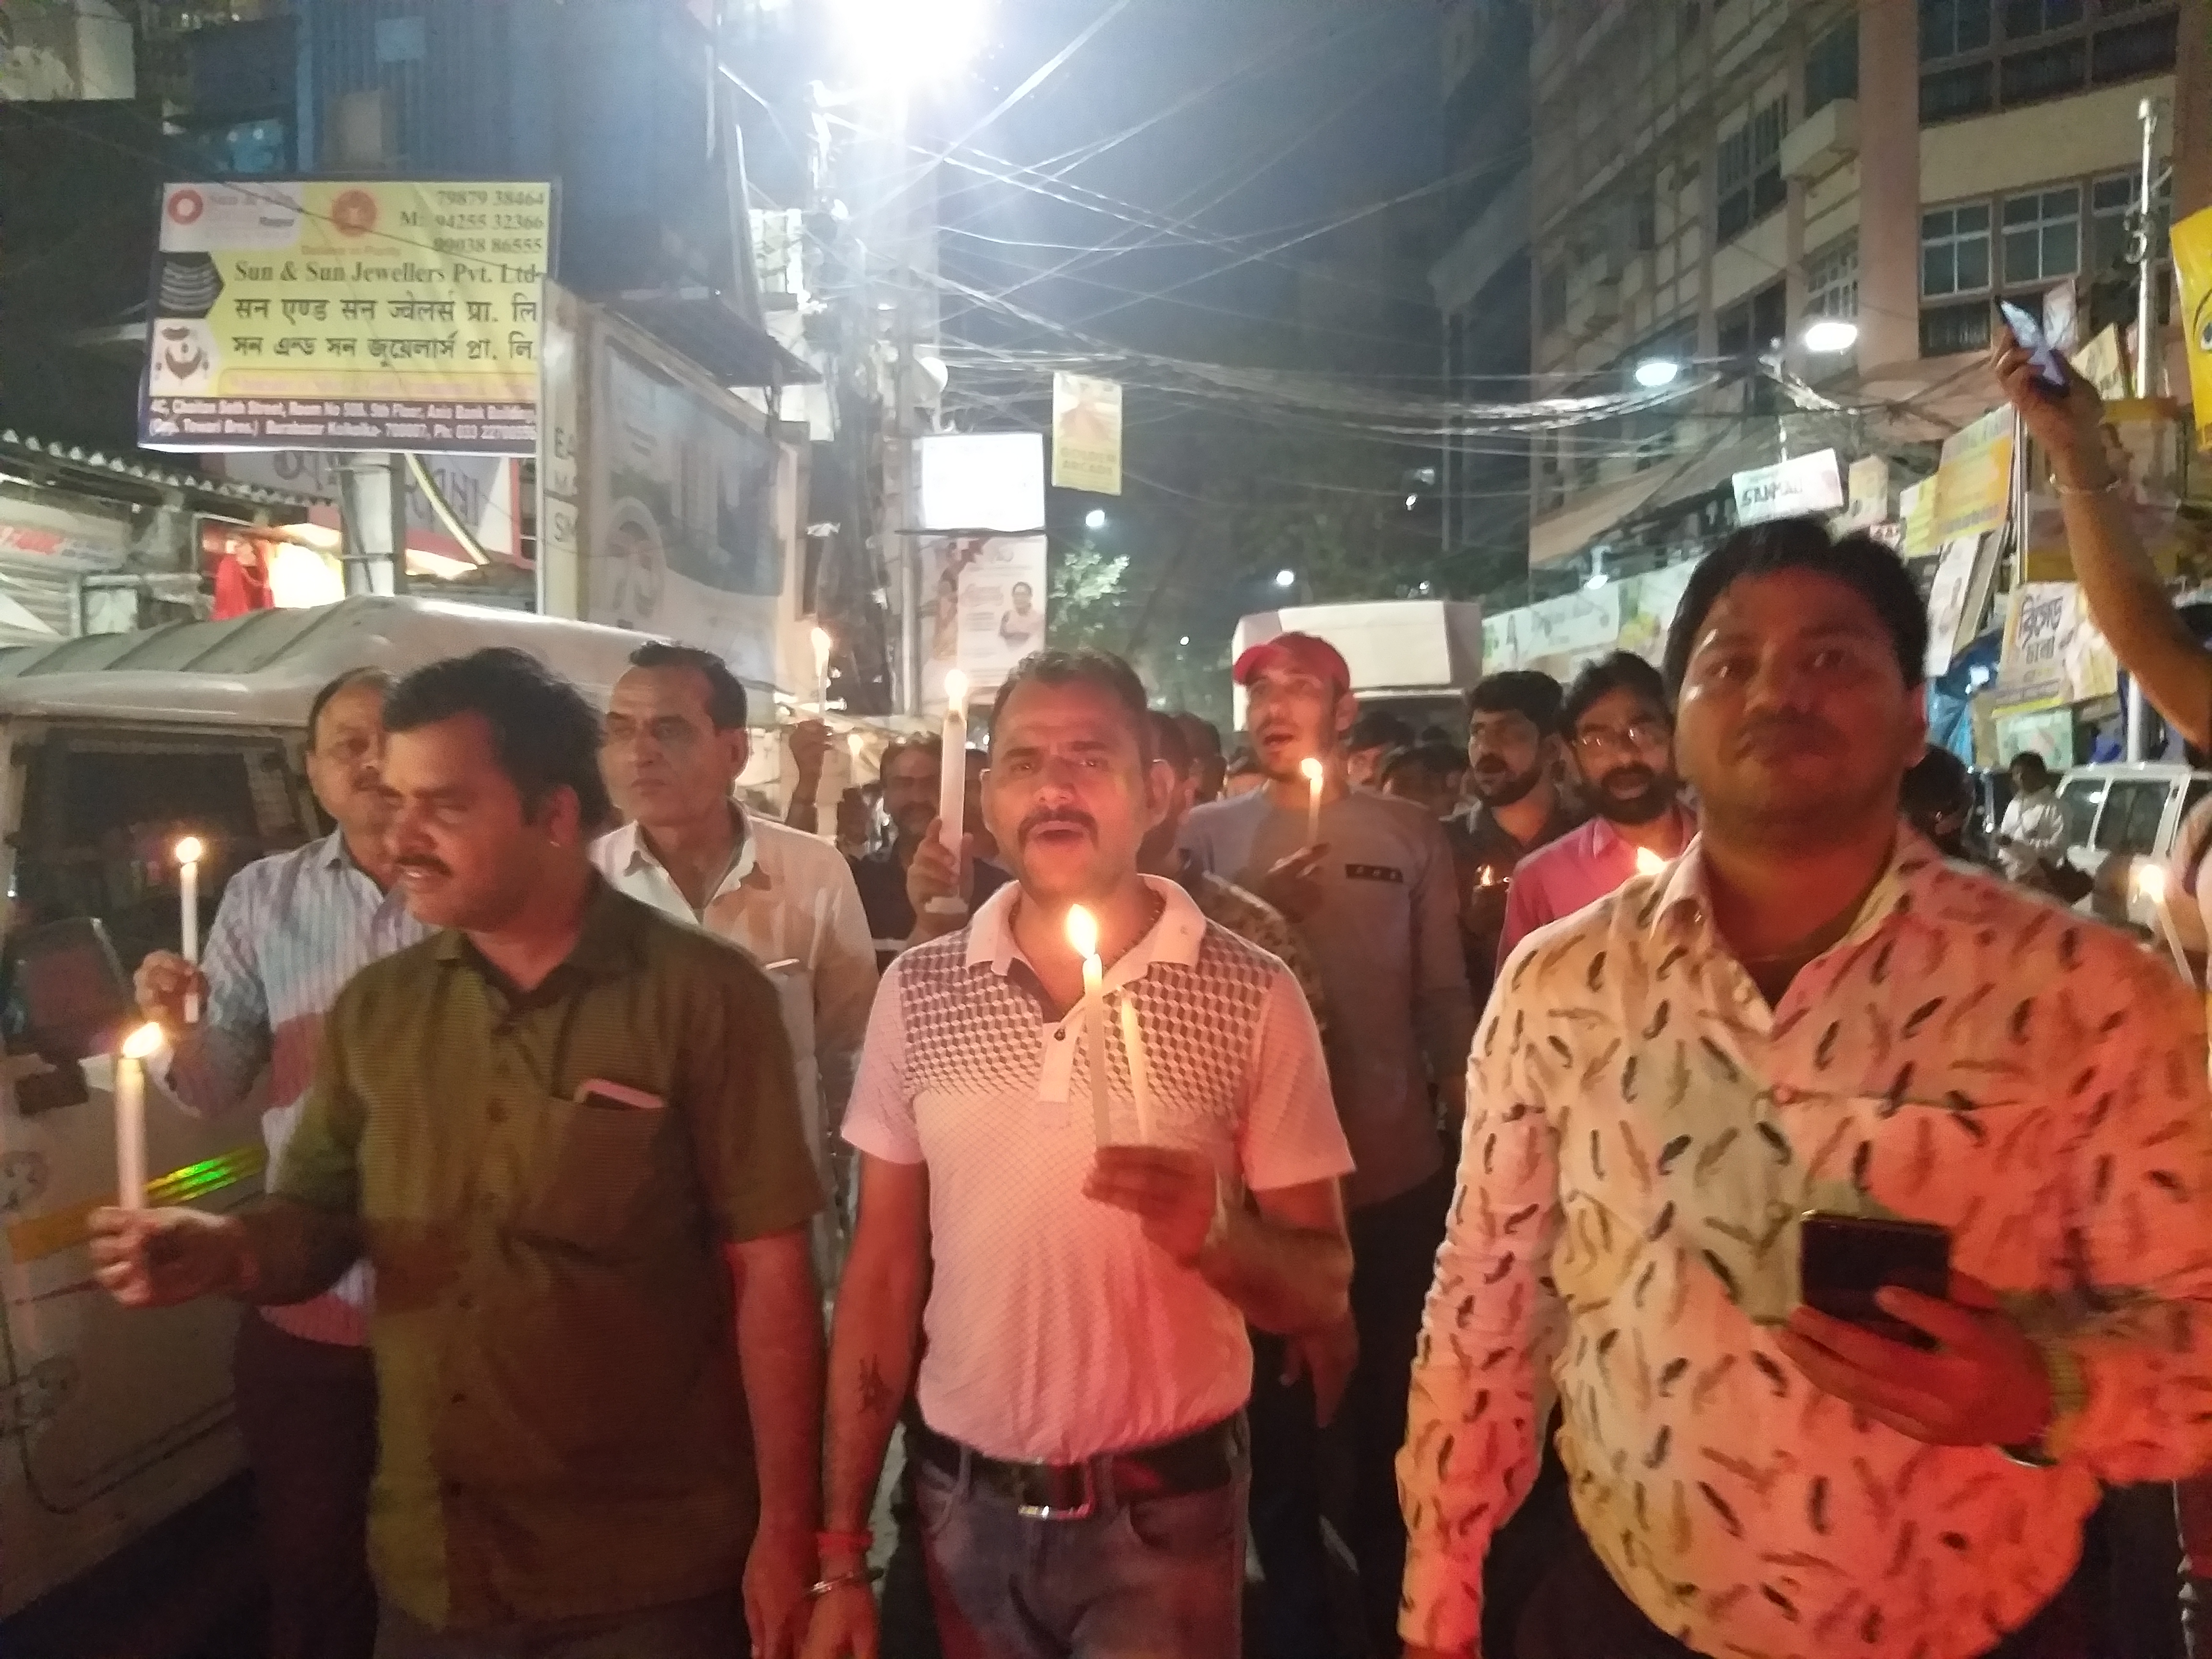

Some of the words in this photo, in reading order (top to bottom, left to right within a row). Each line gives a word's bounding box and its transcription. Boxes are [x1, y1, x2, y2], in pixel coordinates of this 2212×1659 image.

[234, 260, 273, 281] Sun
[280, 260, 298, 281] &
[306, 261, 346, 282] Sun
[351, 262, 445, 282] Jewellers
[234, 299, 272, 320] सन
[281, 299, 331, 325] एण्ड
[340, 300, 379, 321] सन
[232, 337, 264, 356] সন
[325, 338, 357, 357] সন
